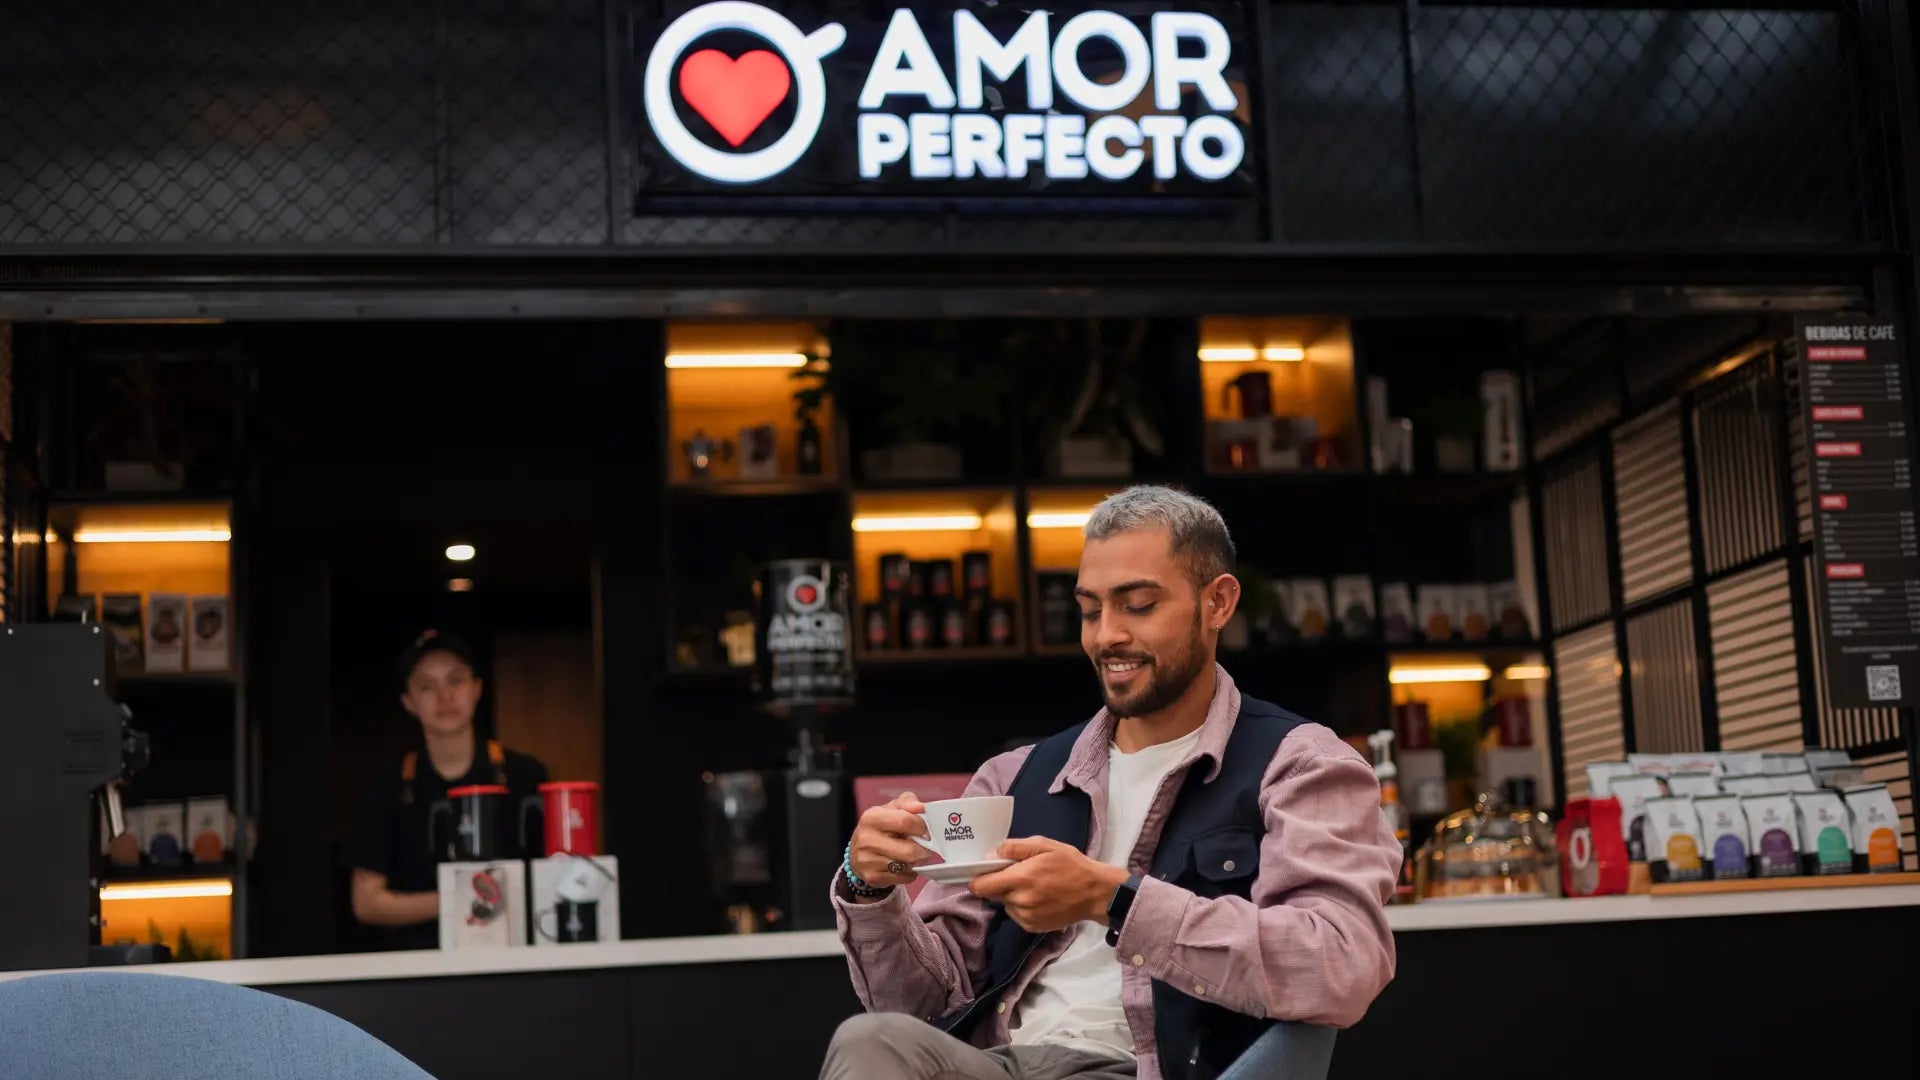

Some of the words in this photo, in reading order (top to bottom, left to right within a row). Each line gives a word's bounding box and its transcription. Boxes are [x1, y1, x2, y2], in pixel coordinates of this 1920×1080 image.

[858, 8, 1238, 111] AMOR
[858, 114, 1245, 180] PERFECTO
[1806, 326, 1851, 340] BEBIDAS
[1853, 326, 1867, 340] DE
[944, 826, 972, 835] AMOR
